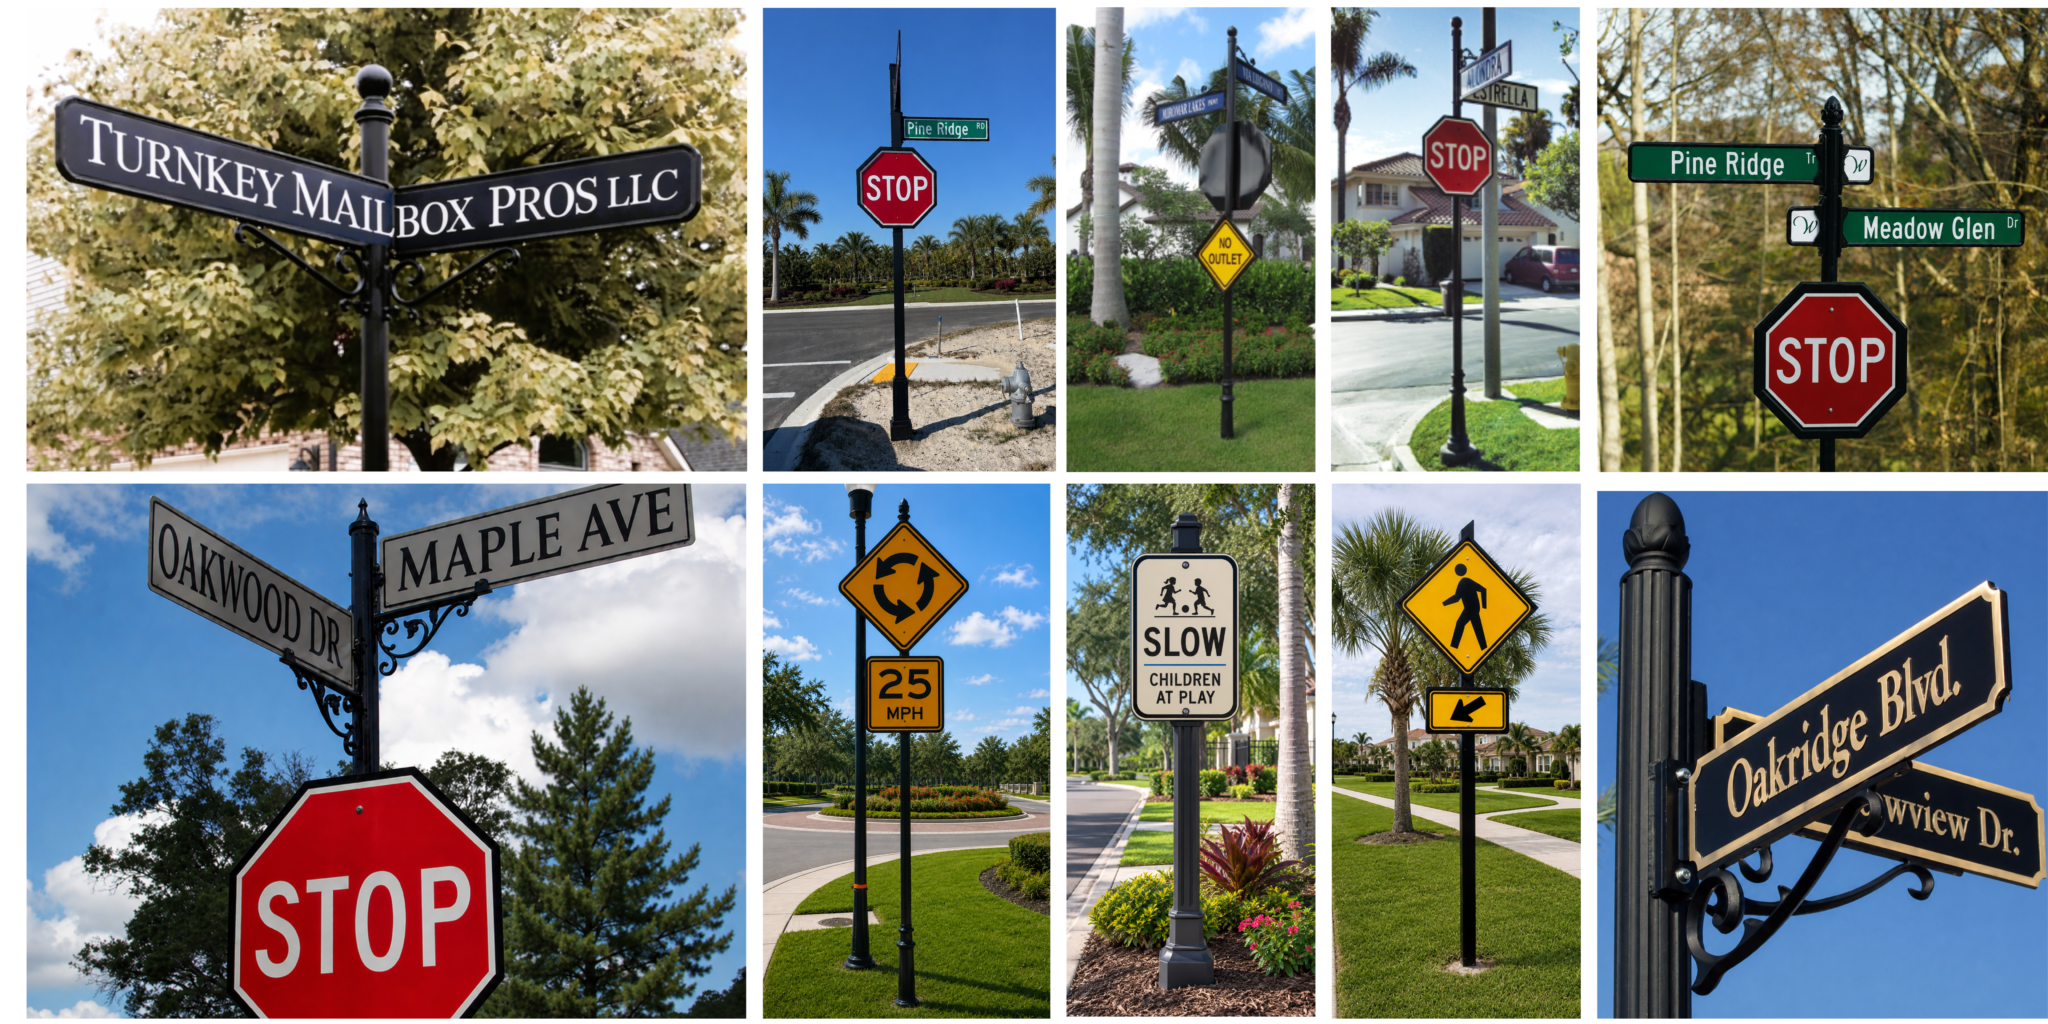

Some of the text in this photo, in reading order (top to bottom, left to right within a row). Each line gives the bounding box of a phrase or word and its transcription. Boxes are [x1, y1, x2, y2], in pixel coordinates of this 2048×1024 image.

[1242, 66, 1252, 82] VIA
[1467, 51, 1503, 90] ALONDRA
[1162, 102, 1188, 120] MIROMAR
[1188, 98, 1206, 113] LAKES
[907, 121, 985, 139] Pine Ridge RD
[80, 114, 284, 209] TURNKEY
[488, 176, 598, 228] PROS
[607, 168, 679, 209] LLC
[1430, 141, 1487, 171] STOP
[1671, 150, 1717, 175] Pine
[1726, 151, 1785, 180] Ridge
[866, 174, 928, 202] STOP
[1218, 236, 1232, 249] NO
[1863, 215, 2019, 240] Meadow Glen Dr
[1208, 252, 1243, 266] OUTLET
[1776, 336, 1886, 385] STOP
[398, 486, 675, 592] MAPLE AVE
[158, 523, 344, 670] OAKWOOD DR
[1143, 626, 1227, 657] SLOW
[878, 668, 932, 700] 25
[1149, 672, 1221, 687] CHILDREN
[1156, 690, 1216, 704] AT PLAY
[886, 706, 924, 720] MPH
[1726, 634, 1962, 819] Oakridge Blvd.
[1860, 791, 2021, 857] wview Dr.
[254, 865, 472, 979] STOP
